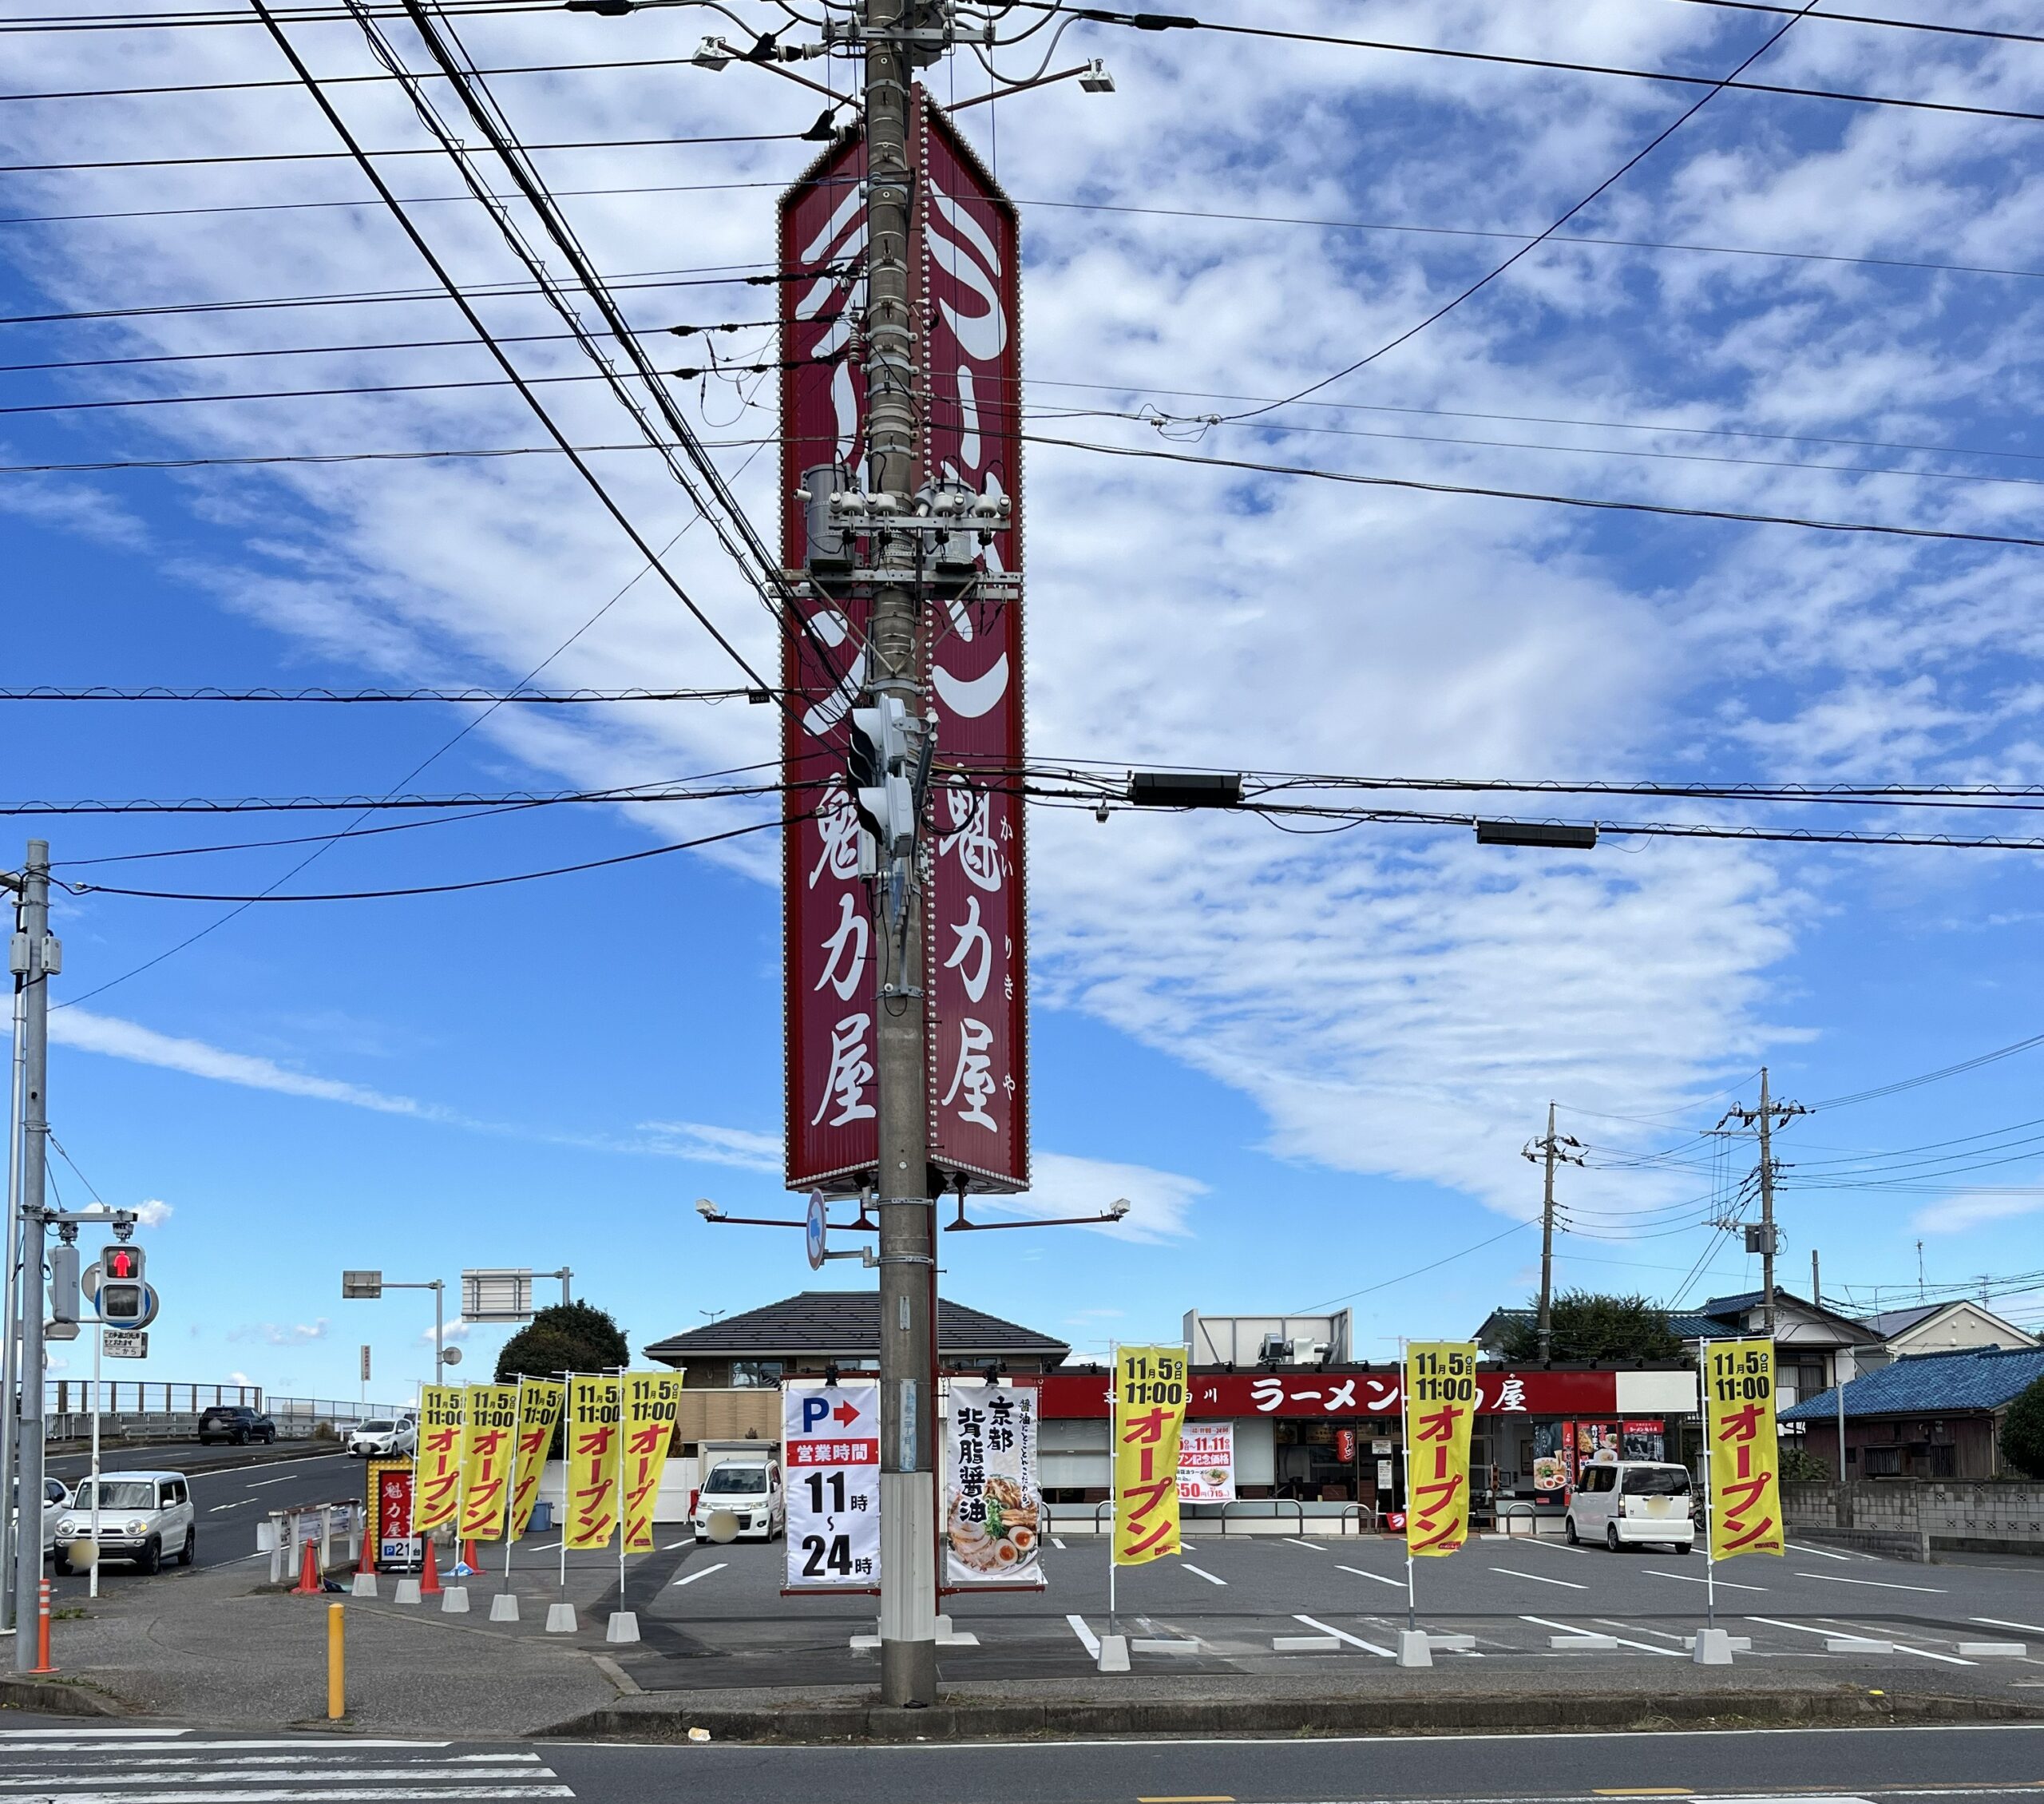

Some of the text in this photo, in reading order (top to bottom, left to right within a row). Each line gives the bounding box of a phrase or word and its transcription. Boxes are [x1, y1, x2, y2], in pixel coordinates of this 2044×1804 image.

[795, 181, 869, 736] ラーン
[939, 763, 1002, 1133] 魁力屋
[631, 1402, 677, 1421] 11:00
[802, 1398, 830, 1433] P
[1125, 1381, 1182, 1405] 11:00
[1250, 1378, 1399, 1411] ラーメン
[1416, 1378, 1472, 1401] 11:00
[1716, 1376, 1770, 1401] 11:00
[473, 1410, 515, 1428] 11:00
[988, 1396, 1015, 1453] 京都
[1345, 1431, 1353, 1460] ラーメン
[422, 1428, 461, 1524] オープン
[462, 1429, 508, 1532] オープン
[796, 1443, 869, 1463] 営業時間
[957, 1407, 987, 1523] 背脂醤油
[1409, 1404, 1464, 1551] オープン
[1718, 1403, 1773, 1550] オープン
[576, 1425, 616, 1544] オープン
[625, 1423, 670, 1546] オープン
[804, 1471, 869, 1513] 11時
[1123, 1406, 1175, 1557] オープン
[383, 1482, 402, 1537] 魁力屋
[802, 1534, 873, 1577] 24時
